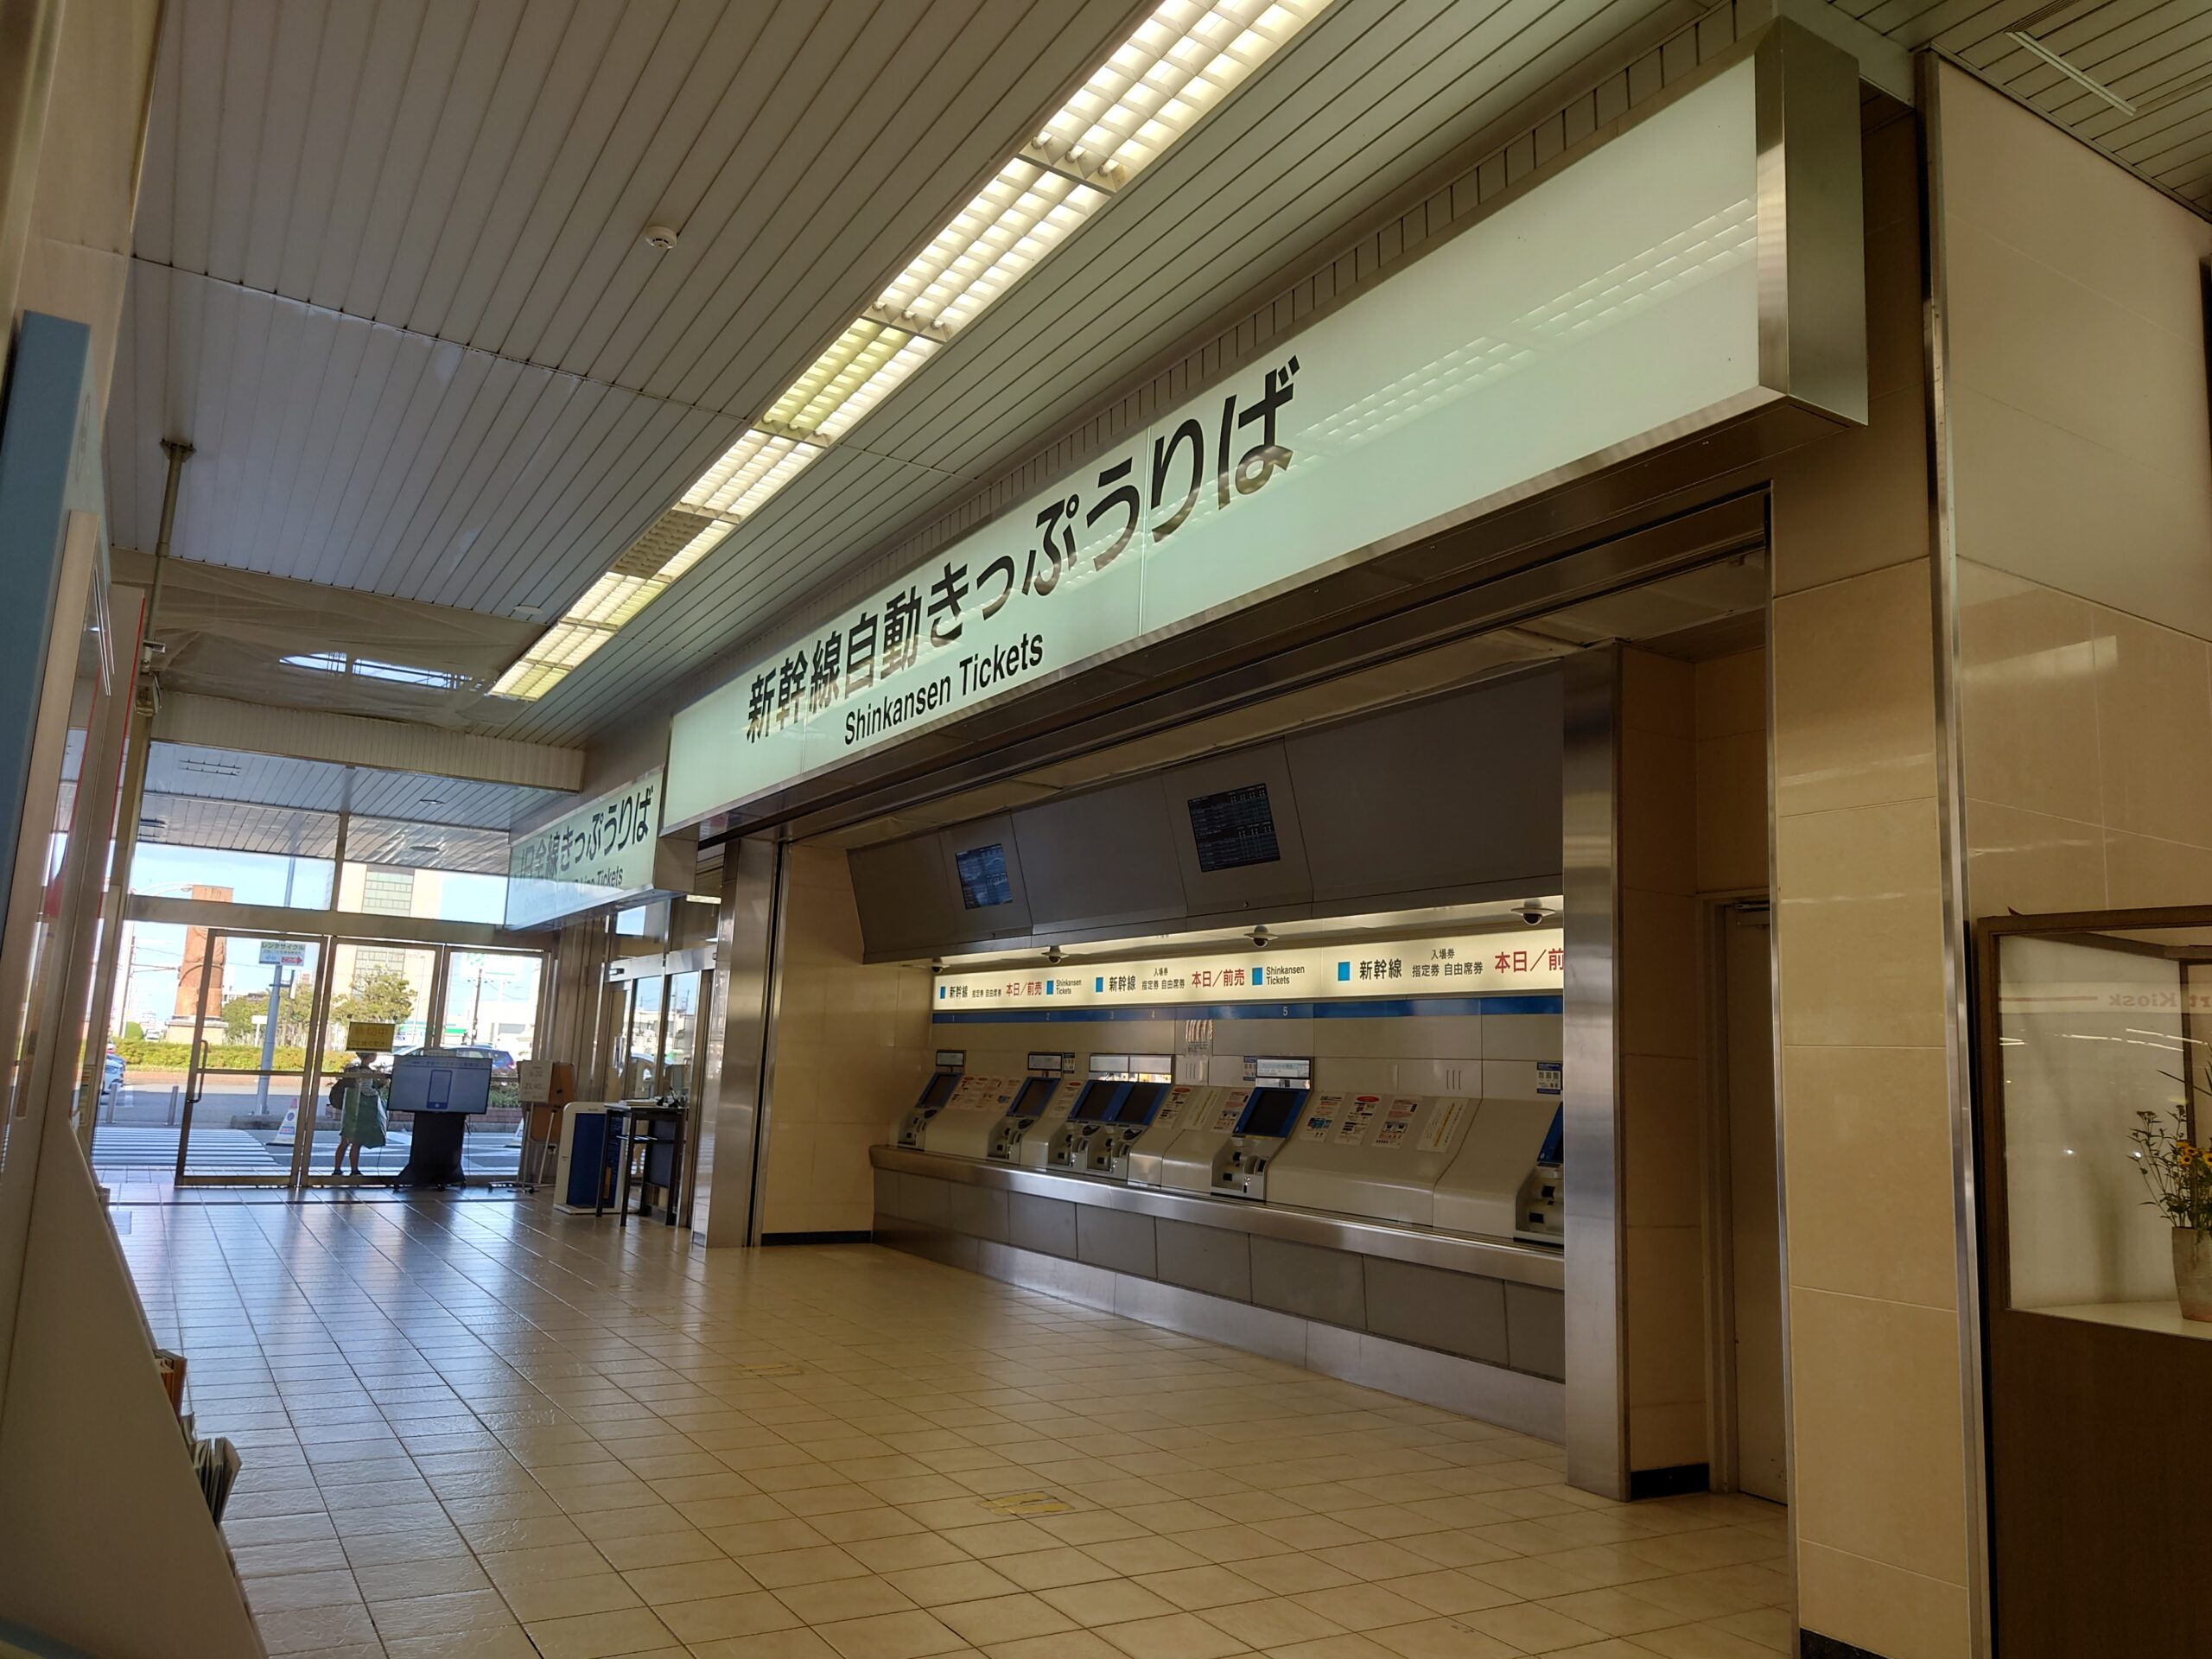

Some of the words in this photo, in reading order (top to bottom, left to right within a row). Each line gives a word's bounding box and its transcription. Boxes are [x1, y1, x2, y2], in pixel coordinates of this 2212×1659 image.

[746, 355, 1301, 744] 新幹線自動きっぷうりば
[845, 672, 951, 747] Shinkansen
[959, 633, 1044, 696] Tickets
[1431, 948, 1455, 960] 入場券
[1266, 965, 1306, 976] Shinkansen
[1359, 958, 1402, 980] 新幹線
[1412, 964, 1440, 977] 指定券
[1444, 962, 1484, 976] 自由席券
[1056, 979, 1082, 988] Shinkansen
[1109, 975, 1136, 992] 新幹線
[1267, 976, 1290, 986] Tickets
[949, 984, 969, 999] 新幹線
[1151, 1009, 1156, 1019] 4
[1282, 1006, 1288, 1016] 5
